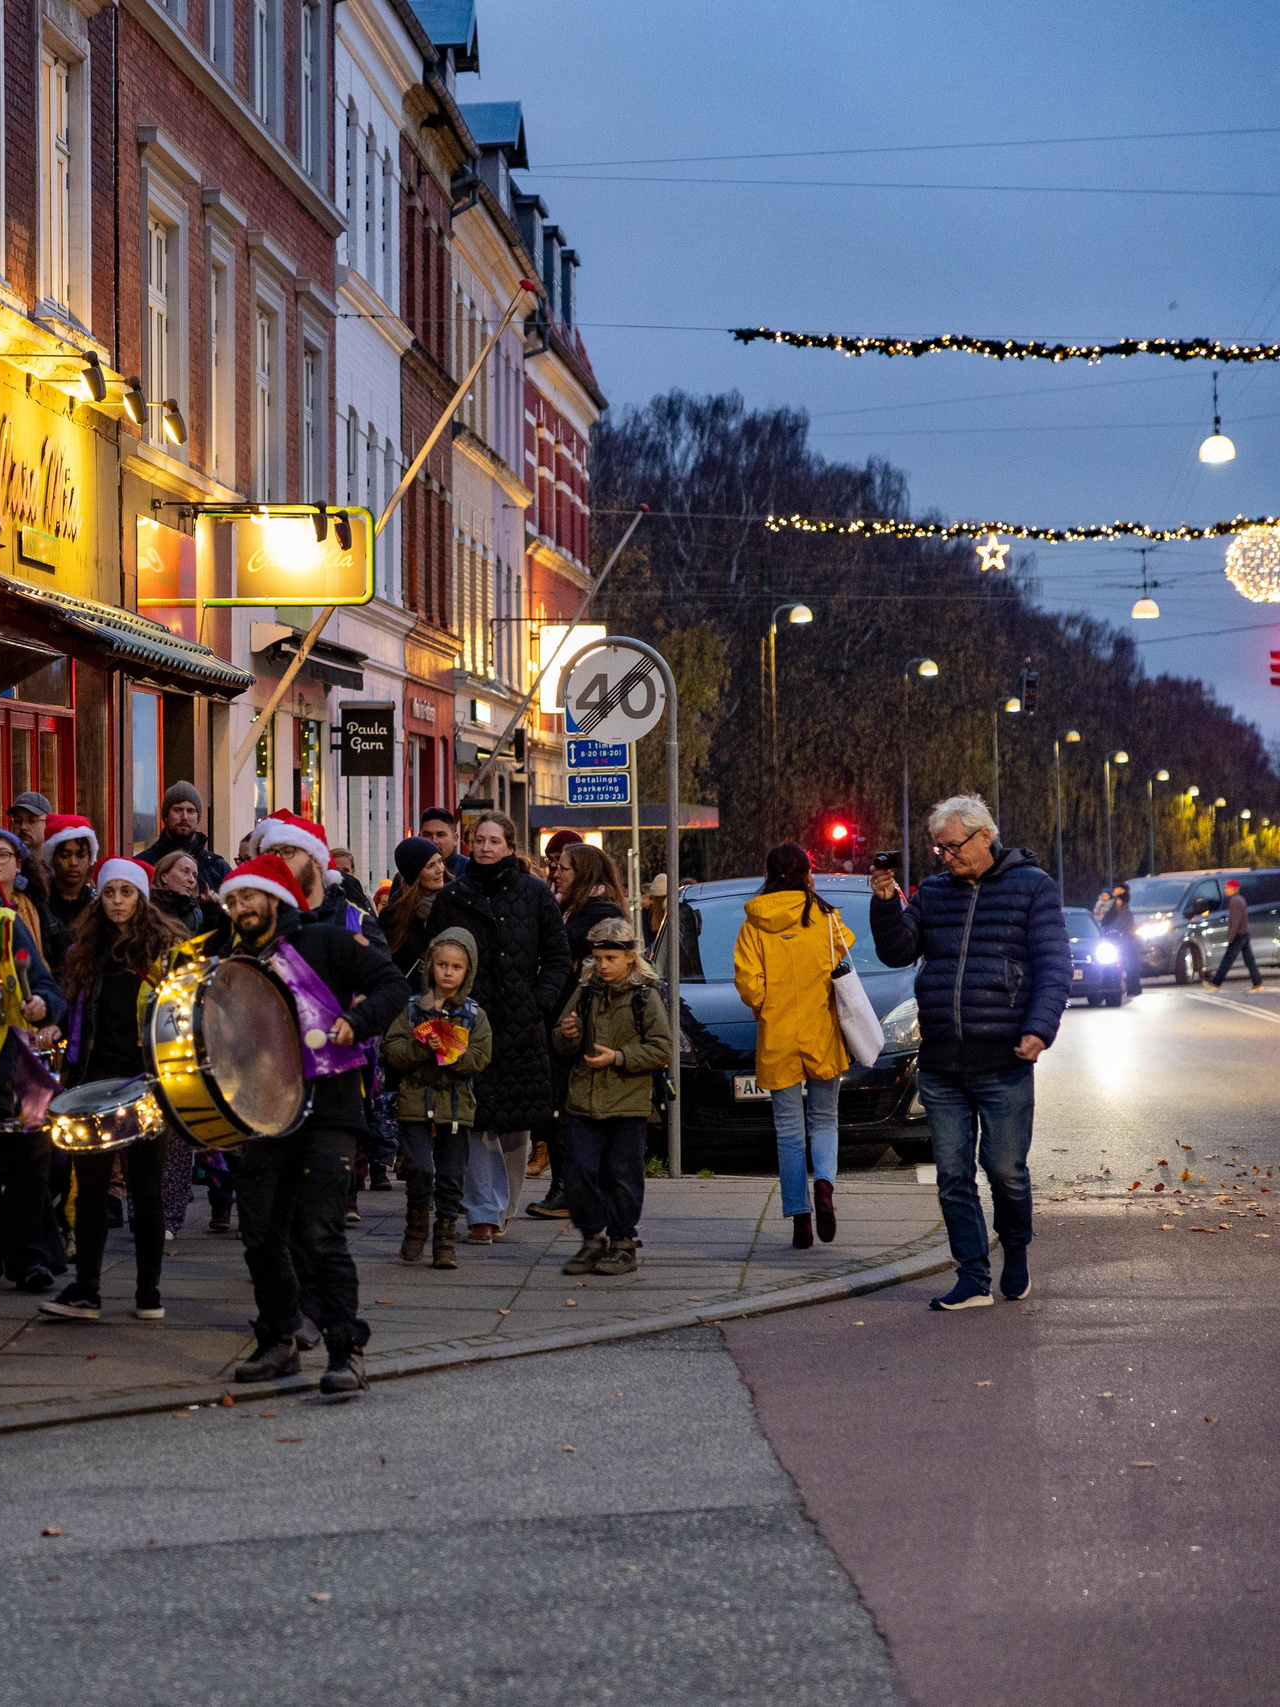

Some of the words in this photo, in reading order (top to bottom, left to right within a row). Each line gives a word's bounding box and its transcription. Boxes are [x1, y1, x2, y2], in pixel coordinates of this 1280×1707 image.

[576, 673, 656, 720] 40
[346, 721, 388, 735] Paula
[350, 736, 384, 753] Garn
[577, 785, 619, 794] parkering
